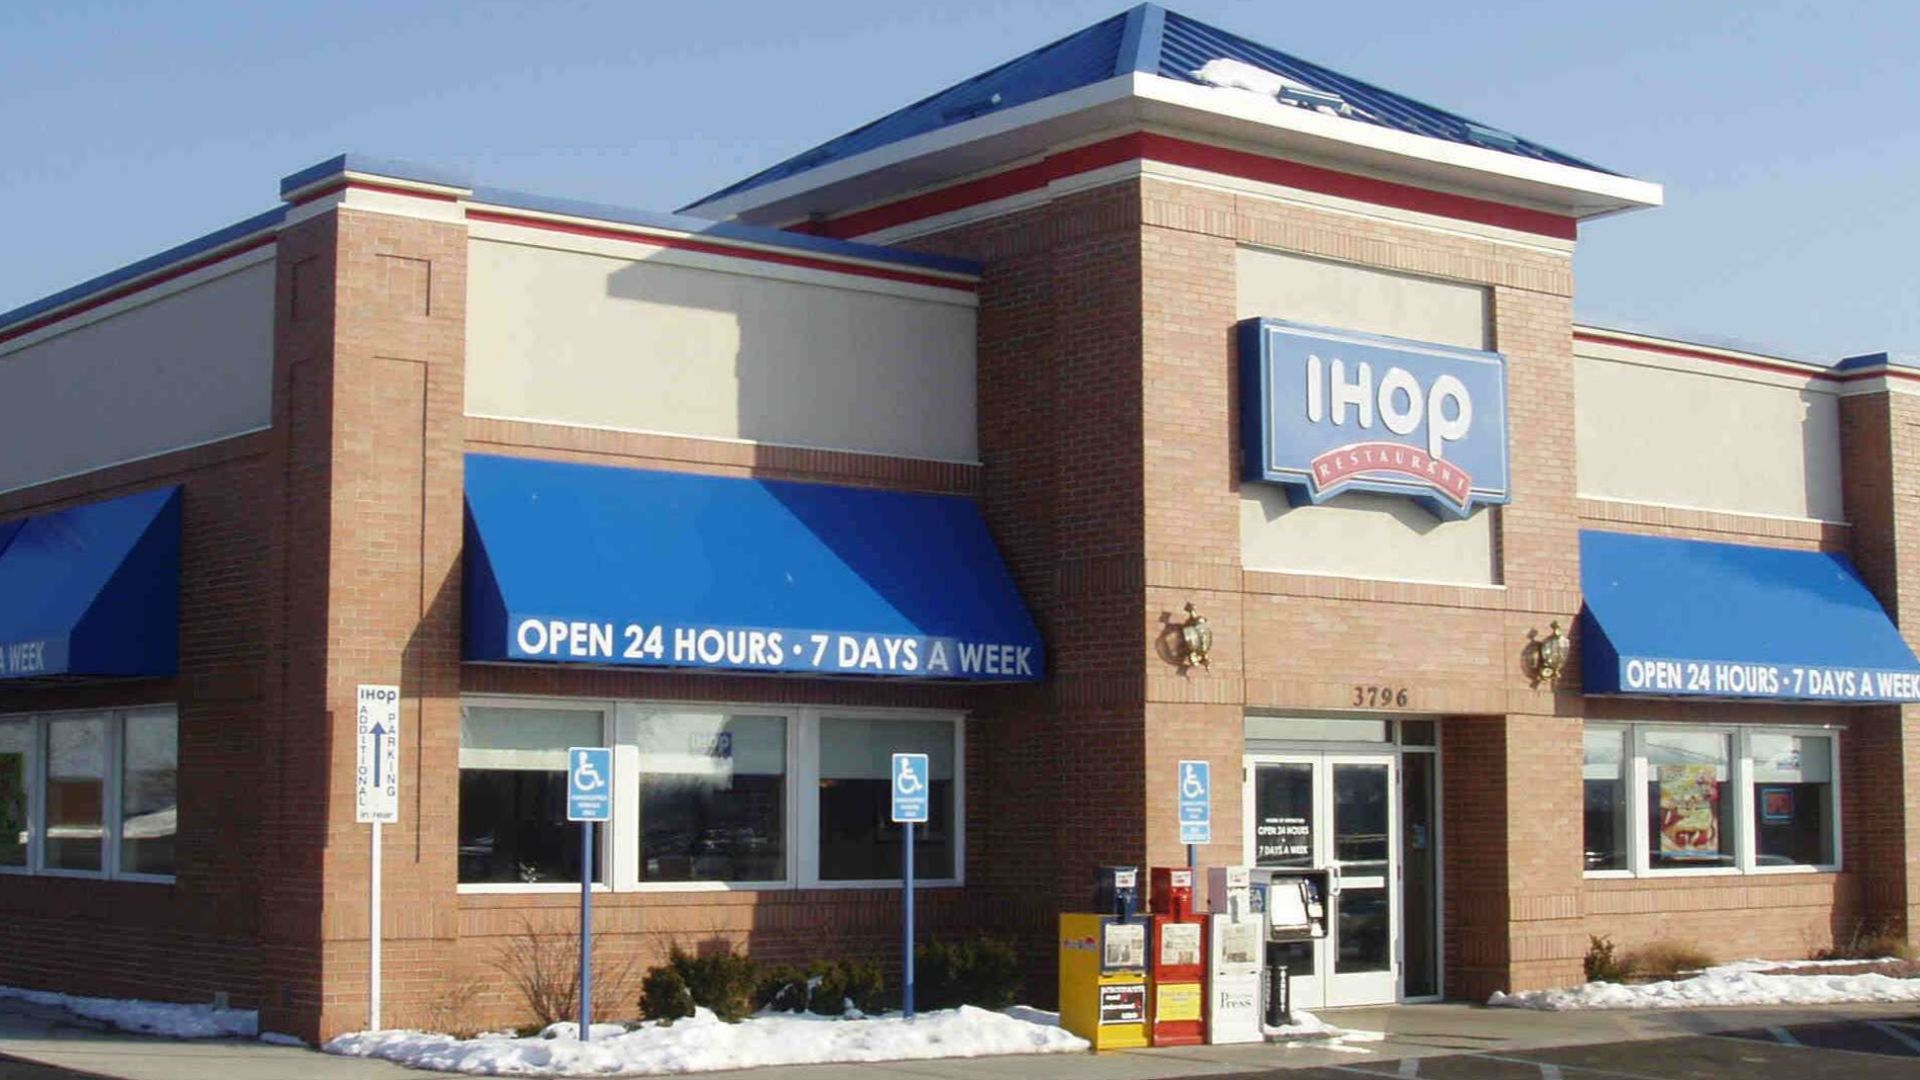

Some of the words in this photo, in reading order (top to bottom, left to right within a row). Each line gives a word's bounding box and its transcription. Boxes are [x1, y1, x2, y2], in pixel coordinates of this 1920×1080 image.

[1306, 354, 1472, 460] IHOP
[1319, 449, 1466, 490] RESTAURANT
[9, 641, 45, 672] WEEK
[517, 619, 613, 657] OPEN
[623, 624, 664, 659] 24
[675, 628, 784, 665] HOURS
[811, 635, 829, 667] 7
[838, 638, 918, 671] DAYS
[927, 641, 949, 671] A
[958, 642, 1033, 675] WEEK
[360, 689, 397, 704] IHOP
[1353, 686, 1408, 707] 3796
[1626, 660, 1681, 689] OPEN
[1687, 663, 1710, 690] 24
[1716, 665, 1778, 694] HOURS
[1793, 668, 1803, 694] 7
[1808, 669, 1855, 697] DAYS
[1860, 671, 1874, 697] A
[1876, 672, 1920, 698] WEEK
[359, 705, 368, 806] ADDITIONAL
[386, 713, 396, 797] PARKING
